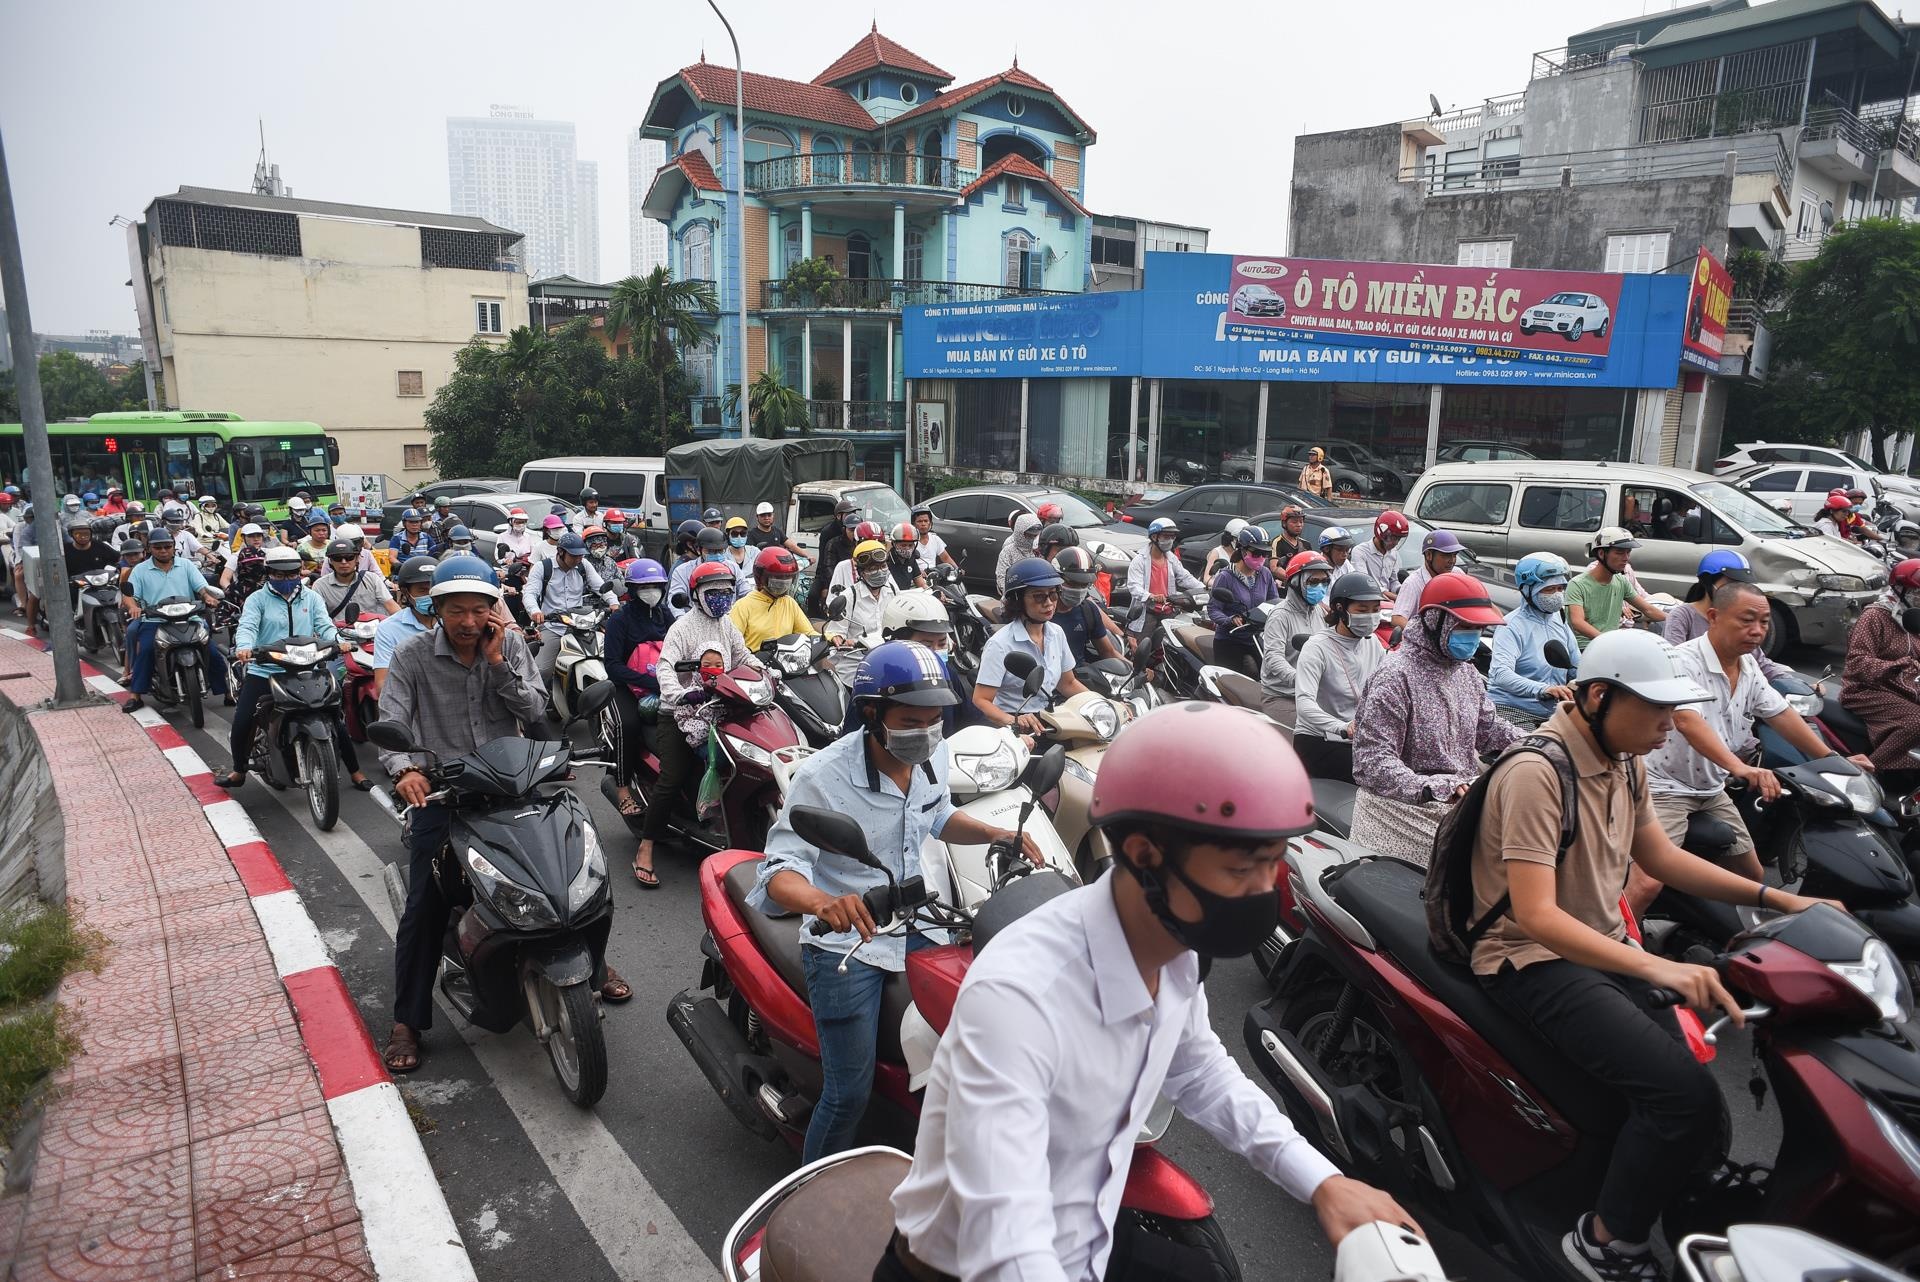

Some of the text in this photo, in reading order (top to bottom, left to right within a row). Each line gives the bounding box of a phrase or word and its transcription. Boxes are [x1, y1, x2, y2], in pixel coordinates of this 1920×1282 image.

[1242, 265, 1262, 274] AUTO
[1196, 291, 1229, 305] CÔNG
[1293, 268, 1521, 324] Ô TÔ MIỀN BẮC
[924, 307, 942, 317] CÔNG
[943, 307, 951, 317] TY
[951, 306, 968, 316] TNHH
[969, 304, 983, 315] ĐẦU
[984, 304, 994, 314] TƯ
[994, 303, 1022, 313] THƯƠNG
[1022, 302, 1037, 313] MẠI
[1290, 314, 1317, 326] CHUYÊN
[1318, 317, 1335, 328] MUA
[1336, 317, 1353, 331] BÁN,
[1355, 320, 1374, 331] TRAO
[1393, 321, 1404, 334] KÝ
[1421, 324, 1436, 336] CÁC
[1437, 327, 1456, 340] LOẠI
[1457, 328, 1469, 339] XE
[1469, 328, 1487, 341] MỚI
[1488, 329, 1499, 342] VÀ
[946, 343, 1087, 363] MUA BÁN KÝ GỬI XE Ô TÔ
[1258, 349, 1301, 363] MUA
[1306, 347, 1348, 363] BÁN
[1422, 343, 1467, 354] 091.355.9079
[1528, 352, 1544, 361] FAX:
[1309, 367, 1320, 375] Nội
[1456, 369, 1481, 377] Hotline:
[1500, 370, 1514, 378] 029
[1514, 370, 1528, 378] 899
[1534, 371, 1597, 379] www.minicars.vn
